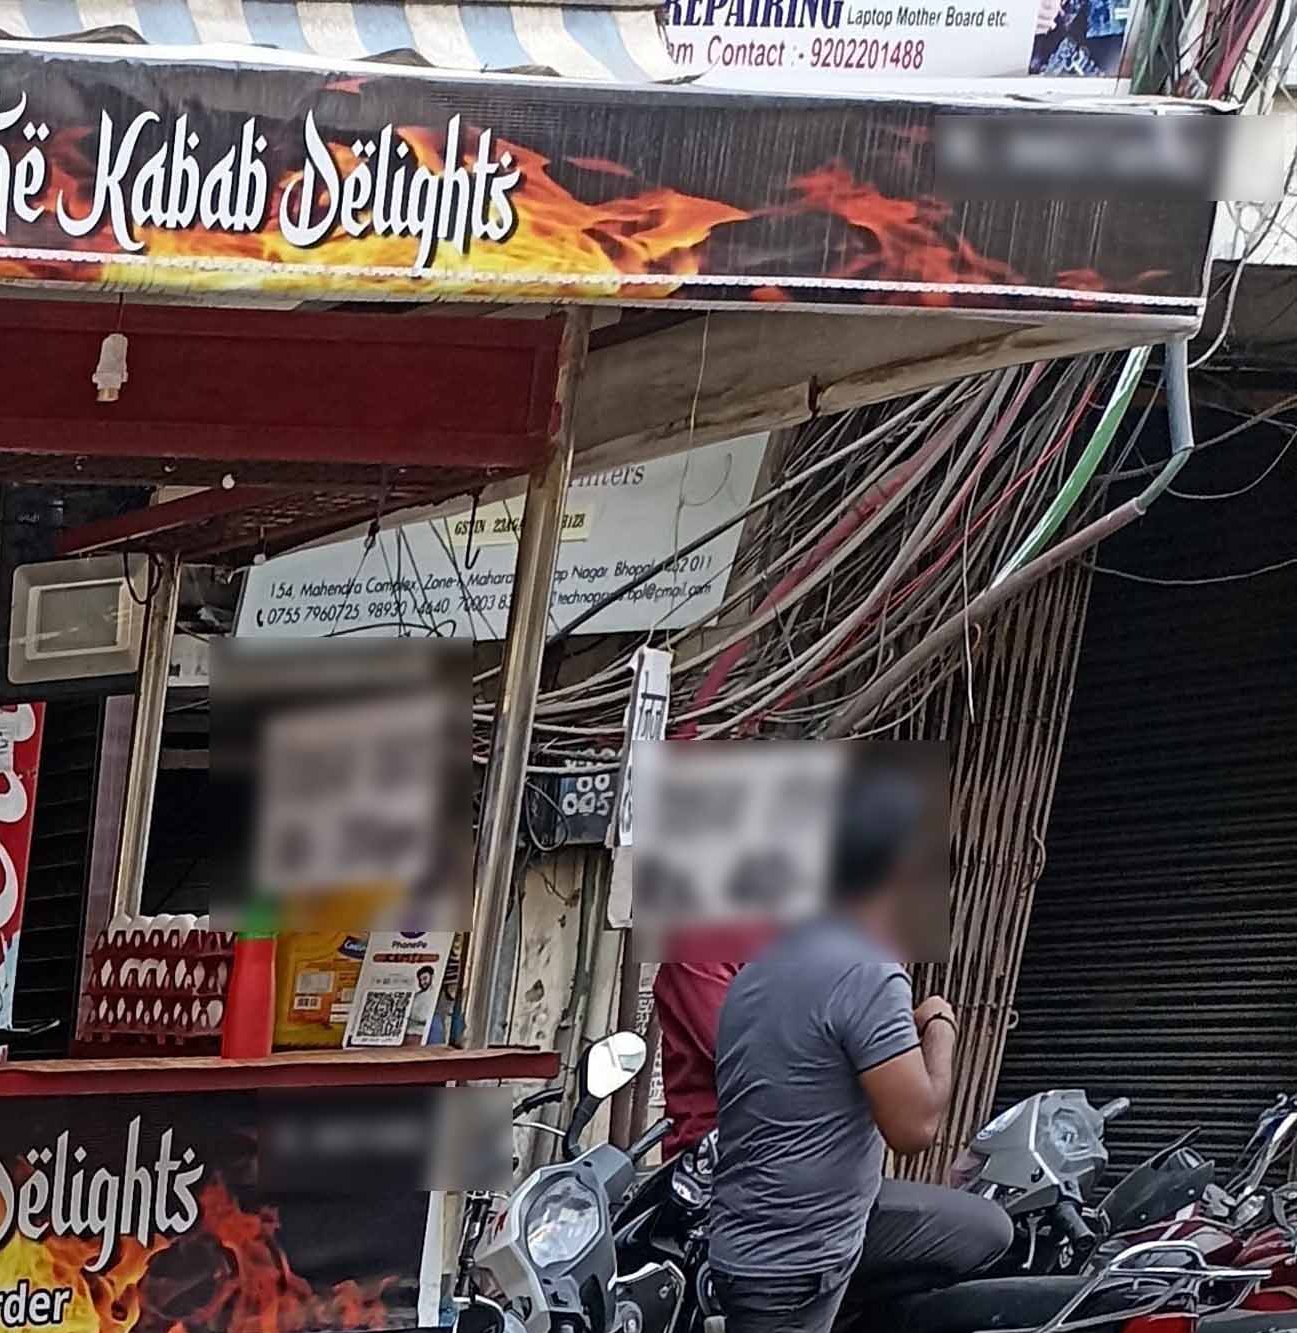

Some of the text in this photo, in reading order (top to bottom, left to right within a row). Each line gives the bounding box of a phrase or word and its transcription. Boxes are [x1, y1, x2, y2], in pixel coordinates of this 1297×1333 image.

[847, 5, 893, 29] Laptop
[896, 6, 942, 26] Mother
[945, 6, 985, 27] Board
[707, 35, 786, 67] Contact
[810, 37, 925, 69] 9202201488
[57, 108, 270, 252] Kabab
[572, 565, 608, 582] Nagar
[267, 607, 301, 625] 0755
